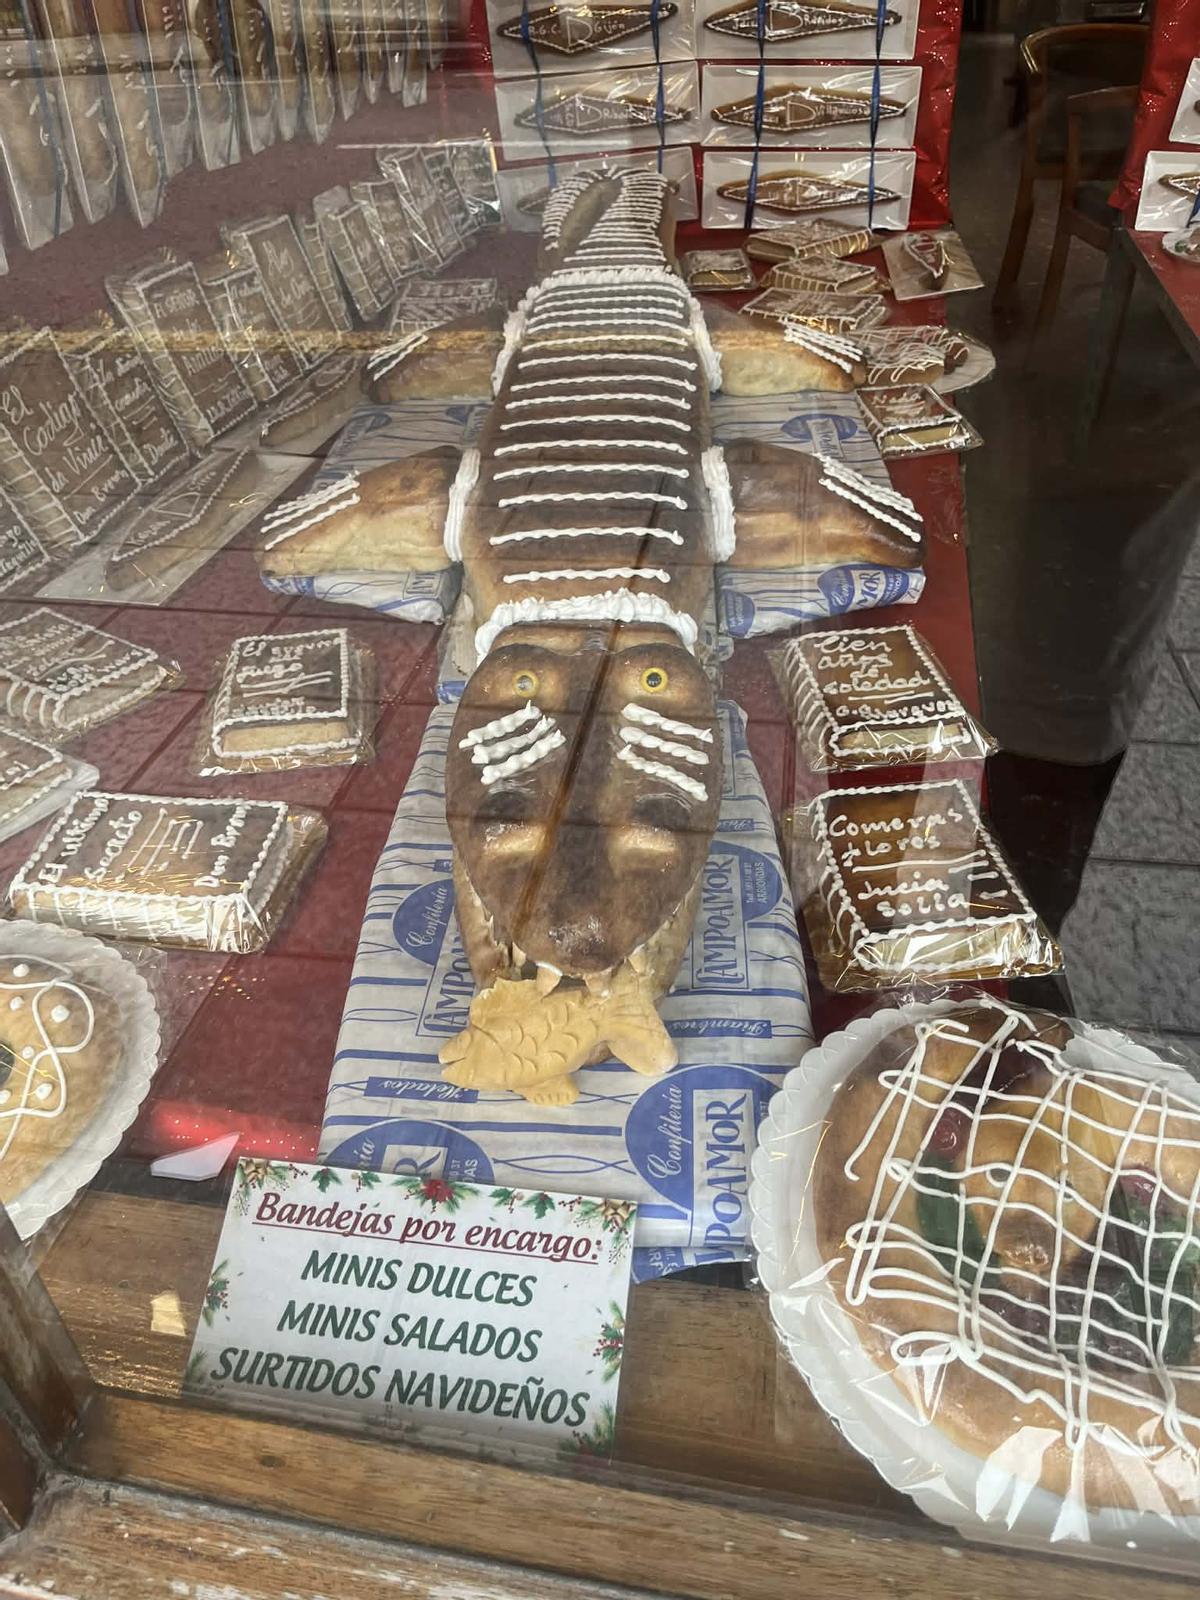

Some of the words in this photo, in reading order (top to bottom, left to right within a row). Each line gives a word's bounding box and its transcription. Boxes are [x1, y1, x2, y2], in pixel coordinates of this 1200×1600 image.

[2, 385, 35, 426] El
[814, 634, 893, 653] Cien
[38, 862, 68, 884] El
[405, 885, 448, 948] Confitería
[695, 856, 745, 985] CAMPOAMOR
[380, 1078, 468, 1100] Helados
[647, 1082, 692, 1180] Confitería
[255, 1191, 396, 1237] Bandejas
[400, 1218, 455, 1244] por
[464, 1222, 604, 1264] encargo:
[300, 1249, 404, 1291] MINIS
[406, 1261, 538, 1308] DULCES
[276, 1299, 382, 1344] MINIS
[383, 1313, 544, 1364] SALADOS
[209, 1346, 382, 1401] SURTIDOS
[384, 1367, 592, 1428] NAVIDEÑOS
